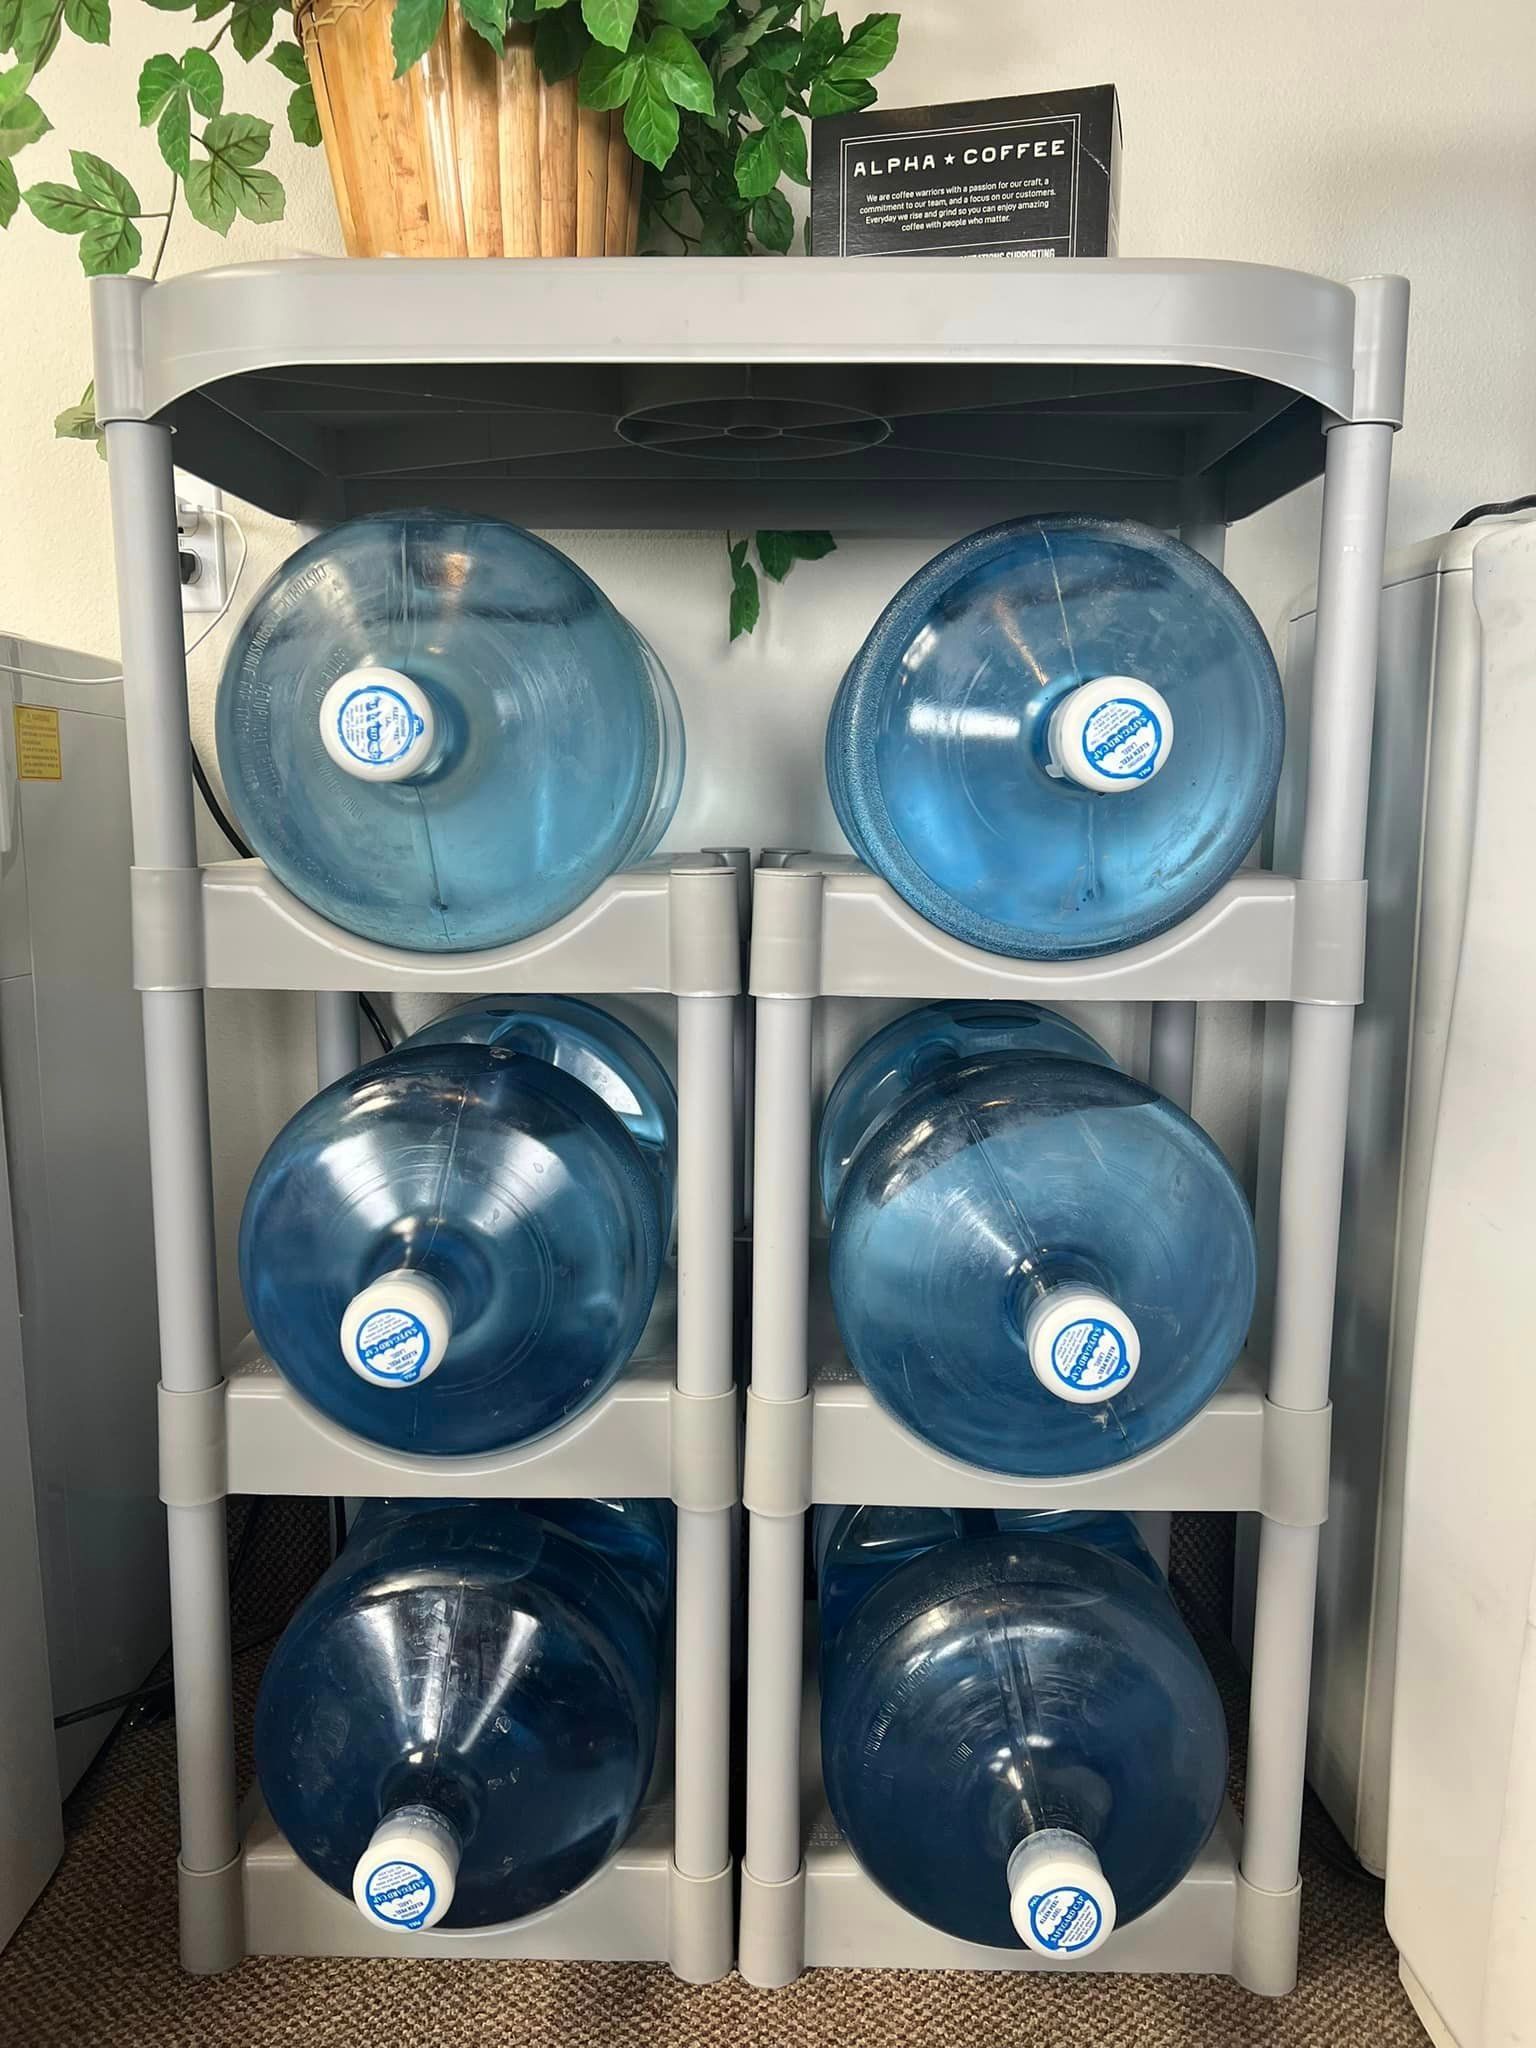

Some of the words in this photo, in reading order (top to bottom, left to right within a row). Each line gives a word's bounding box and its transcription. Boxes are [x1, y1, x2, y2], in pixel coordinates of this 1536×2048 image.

[854, 154, 936, 177] ALPHA
[963, 140, 1066, 165] COFFEE
[866, 194, 877, 202] We
[879, 193, 890, 201] are
[891, 191, 914, 200] coffee
[915, 188, 945, 197] warriors
[946, 185, 962, 194] with
[963, 185, 968, 193] a
[969, 182, 997, 193] passion
[998, 181, 1008, 189] for
[1023, 178, 1043, 187] craft,
[860, 203, 905, 214] commitment
[927, 199, 948, 207] team,
[948, 196, 963, 205] and
[970, 194, 990, 203] focus
[991, 193, 1000, 201] on
[1001, 192, 1014, 200] our
[865, 214, 897, 225] Everyday
[897, 213, 908, 221] we
[909, 211, 923, 219] rise
[924, 210, 938, 218] and
[938, 207, 957, 218] grind
[968, 206, 981, 215] you
[982, 205, 996, 213] can
[997, 202, 1017, 213] enjoy
[1017, 200, 1049, 210] amazing
[901, 222, 925, 232] coffee
[926, 220, 942, 229] with
[942, 217, 967, 229] people
[968, 216, 983, 225] who
[984, 214, 1011, 223] matter.
[1107, 715, 1146, 747] SAFEGARD
[1092, 744, 1109, 759] CAP
[378, 1326, 417, 1349] SAFEGARD
[1078, 1327, 1101, 1366] SAFEGARD
[364, 1346, 378, 1357] CAP
[1071, 1365, 1082, 1381] CAP
[373, 1894, 386, 1902] CAP
[386, 1880, 425, 1898] SAFEGARD
[1051, 1909, 1075, 1942] SAFEGARD
[1073, 1895, 1083, 1910] CAP
